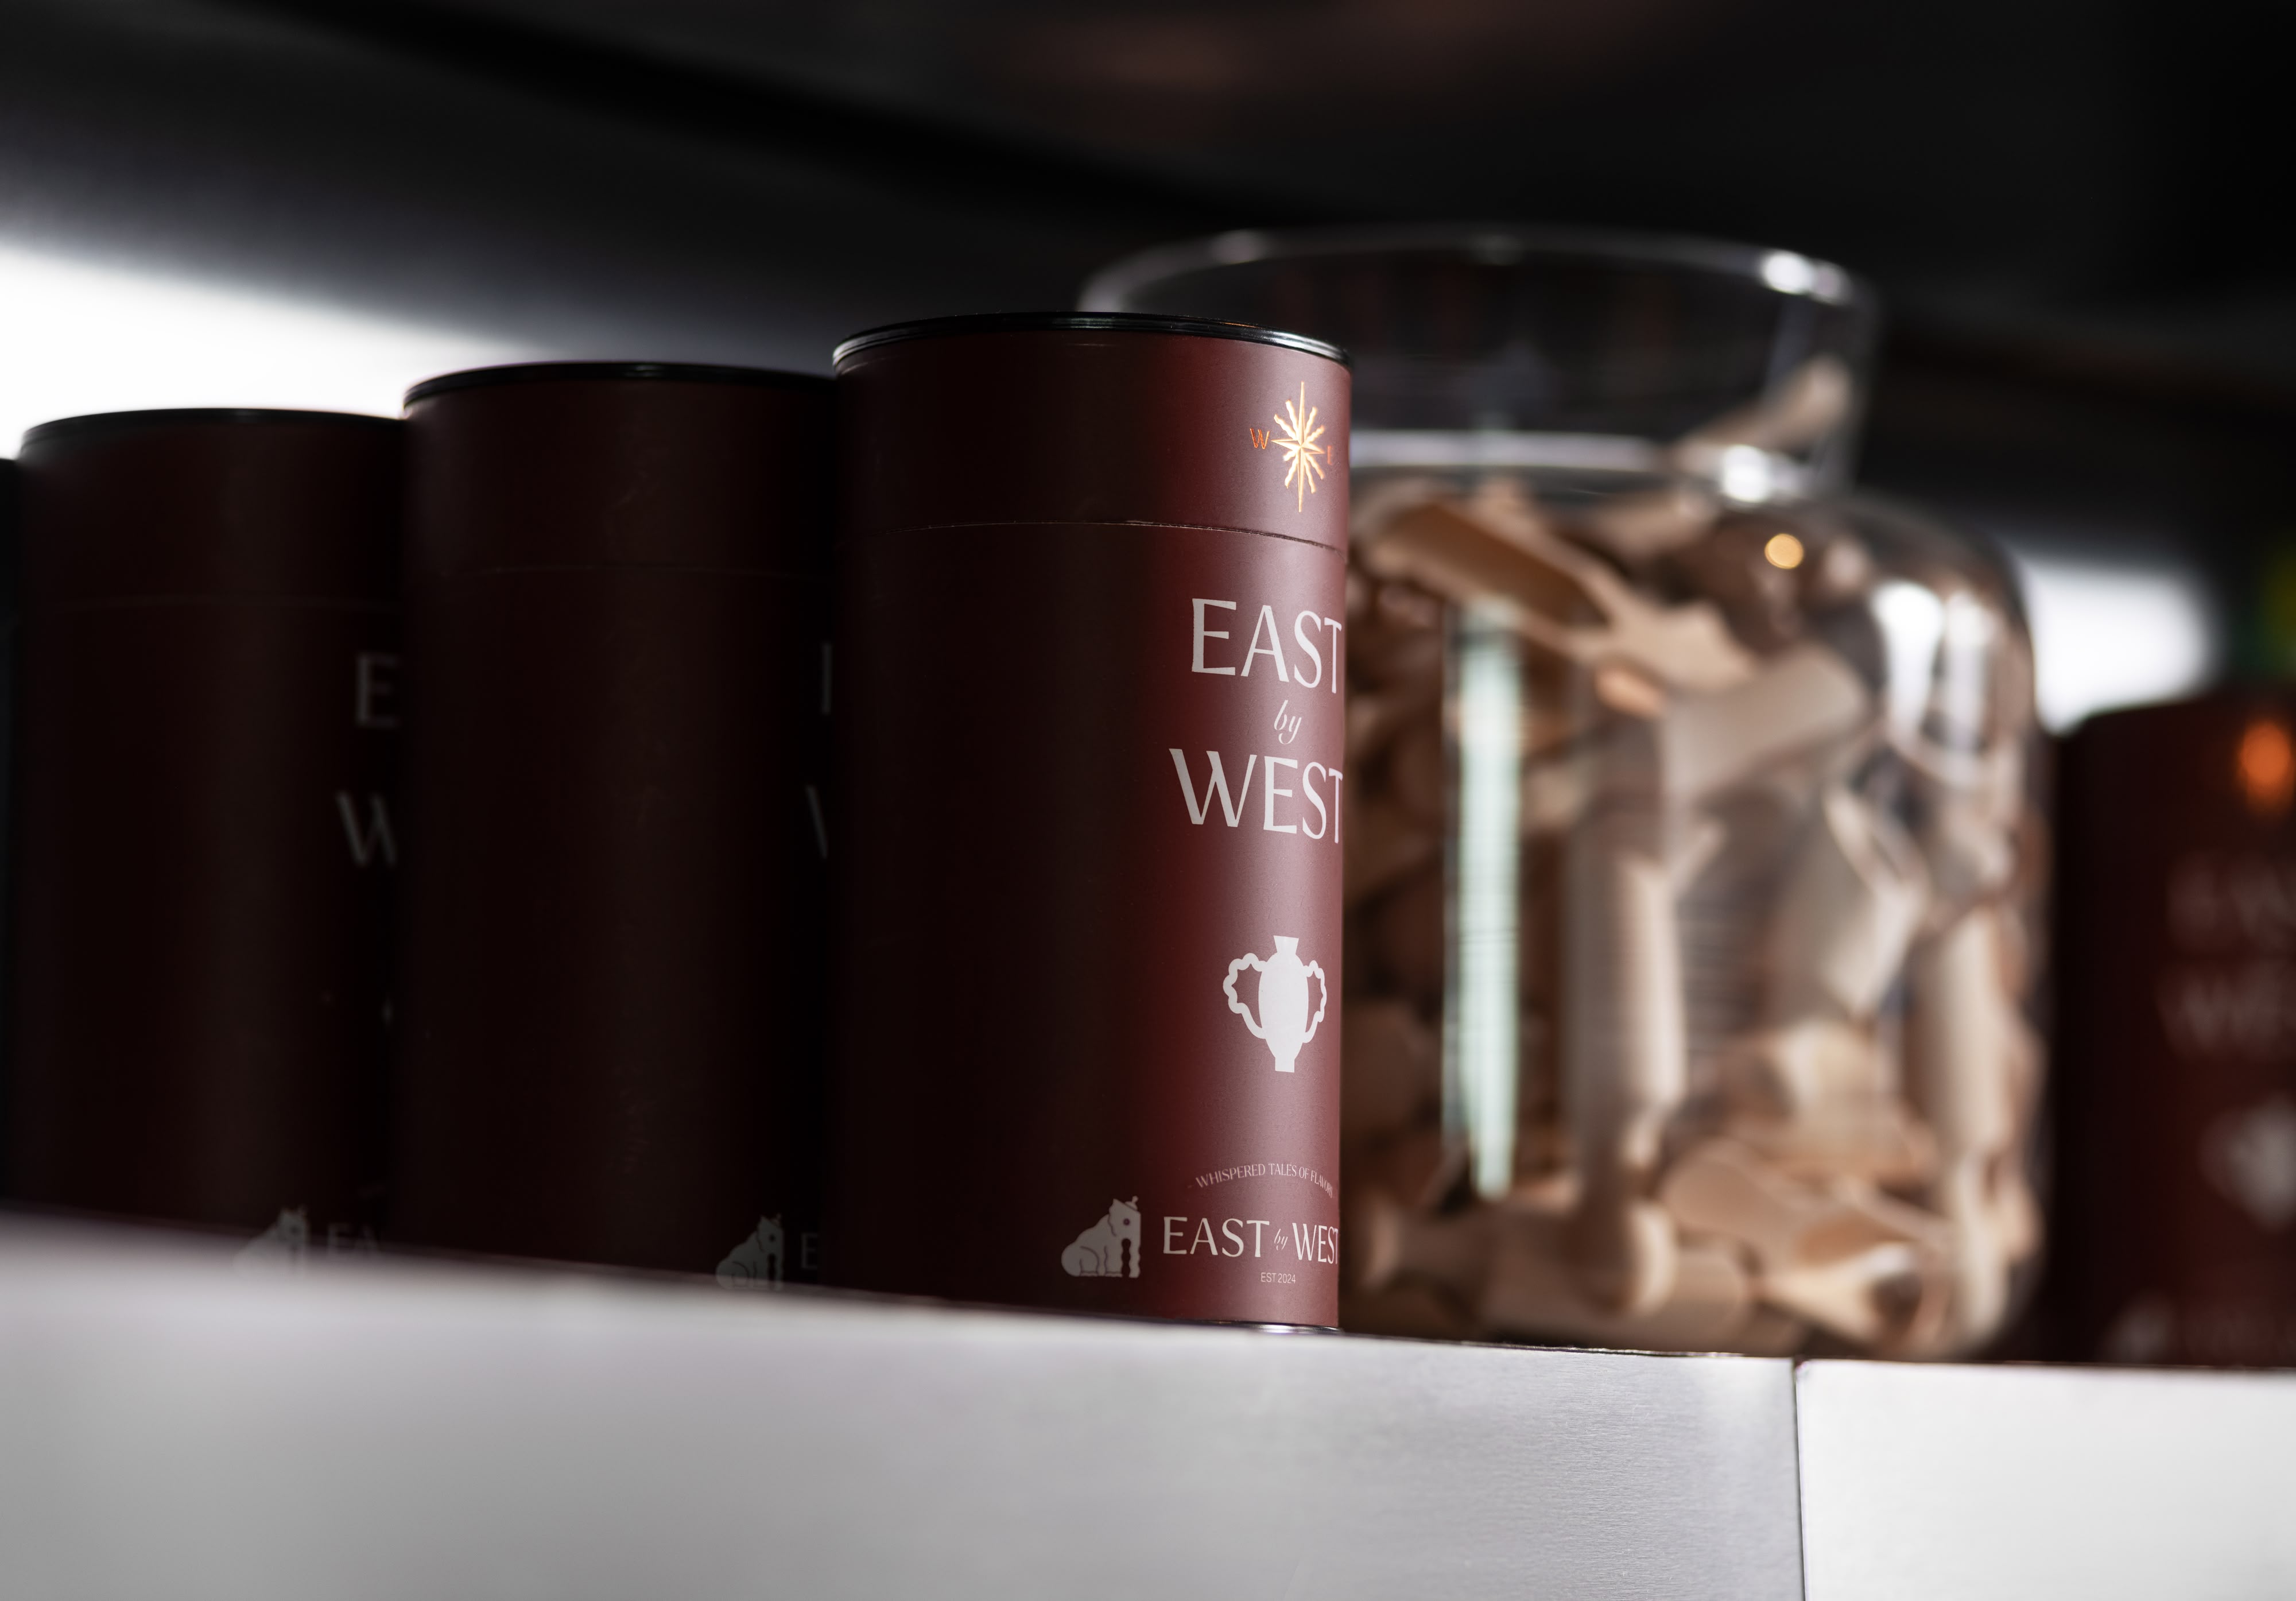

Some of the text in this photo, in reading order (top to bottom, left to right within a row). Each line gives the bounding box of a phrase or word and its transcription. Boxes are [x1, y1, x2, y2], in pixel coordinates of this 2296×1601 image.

[1250, 428, 1270, 449] W
[1192, 598, 1342, 693] EAST
[1274, 700, 1302, 745] by
[1169, 748, 1343, 844] WEST
[1196, 1164, 1265, 1188] WHISPERED
[1268, 1163, 1297, 1177] TALES
[1298, 1166, 1309, 1179] OF
[1163, 1216, 1339, 1265] EAST by WEST
[1261, 1272, 1296, 1284] EST 2024
